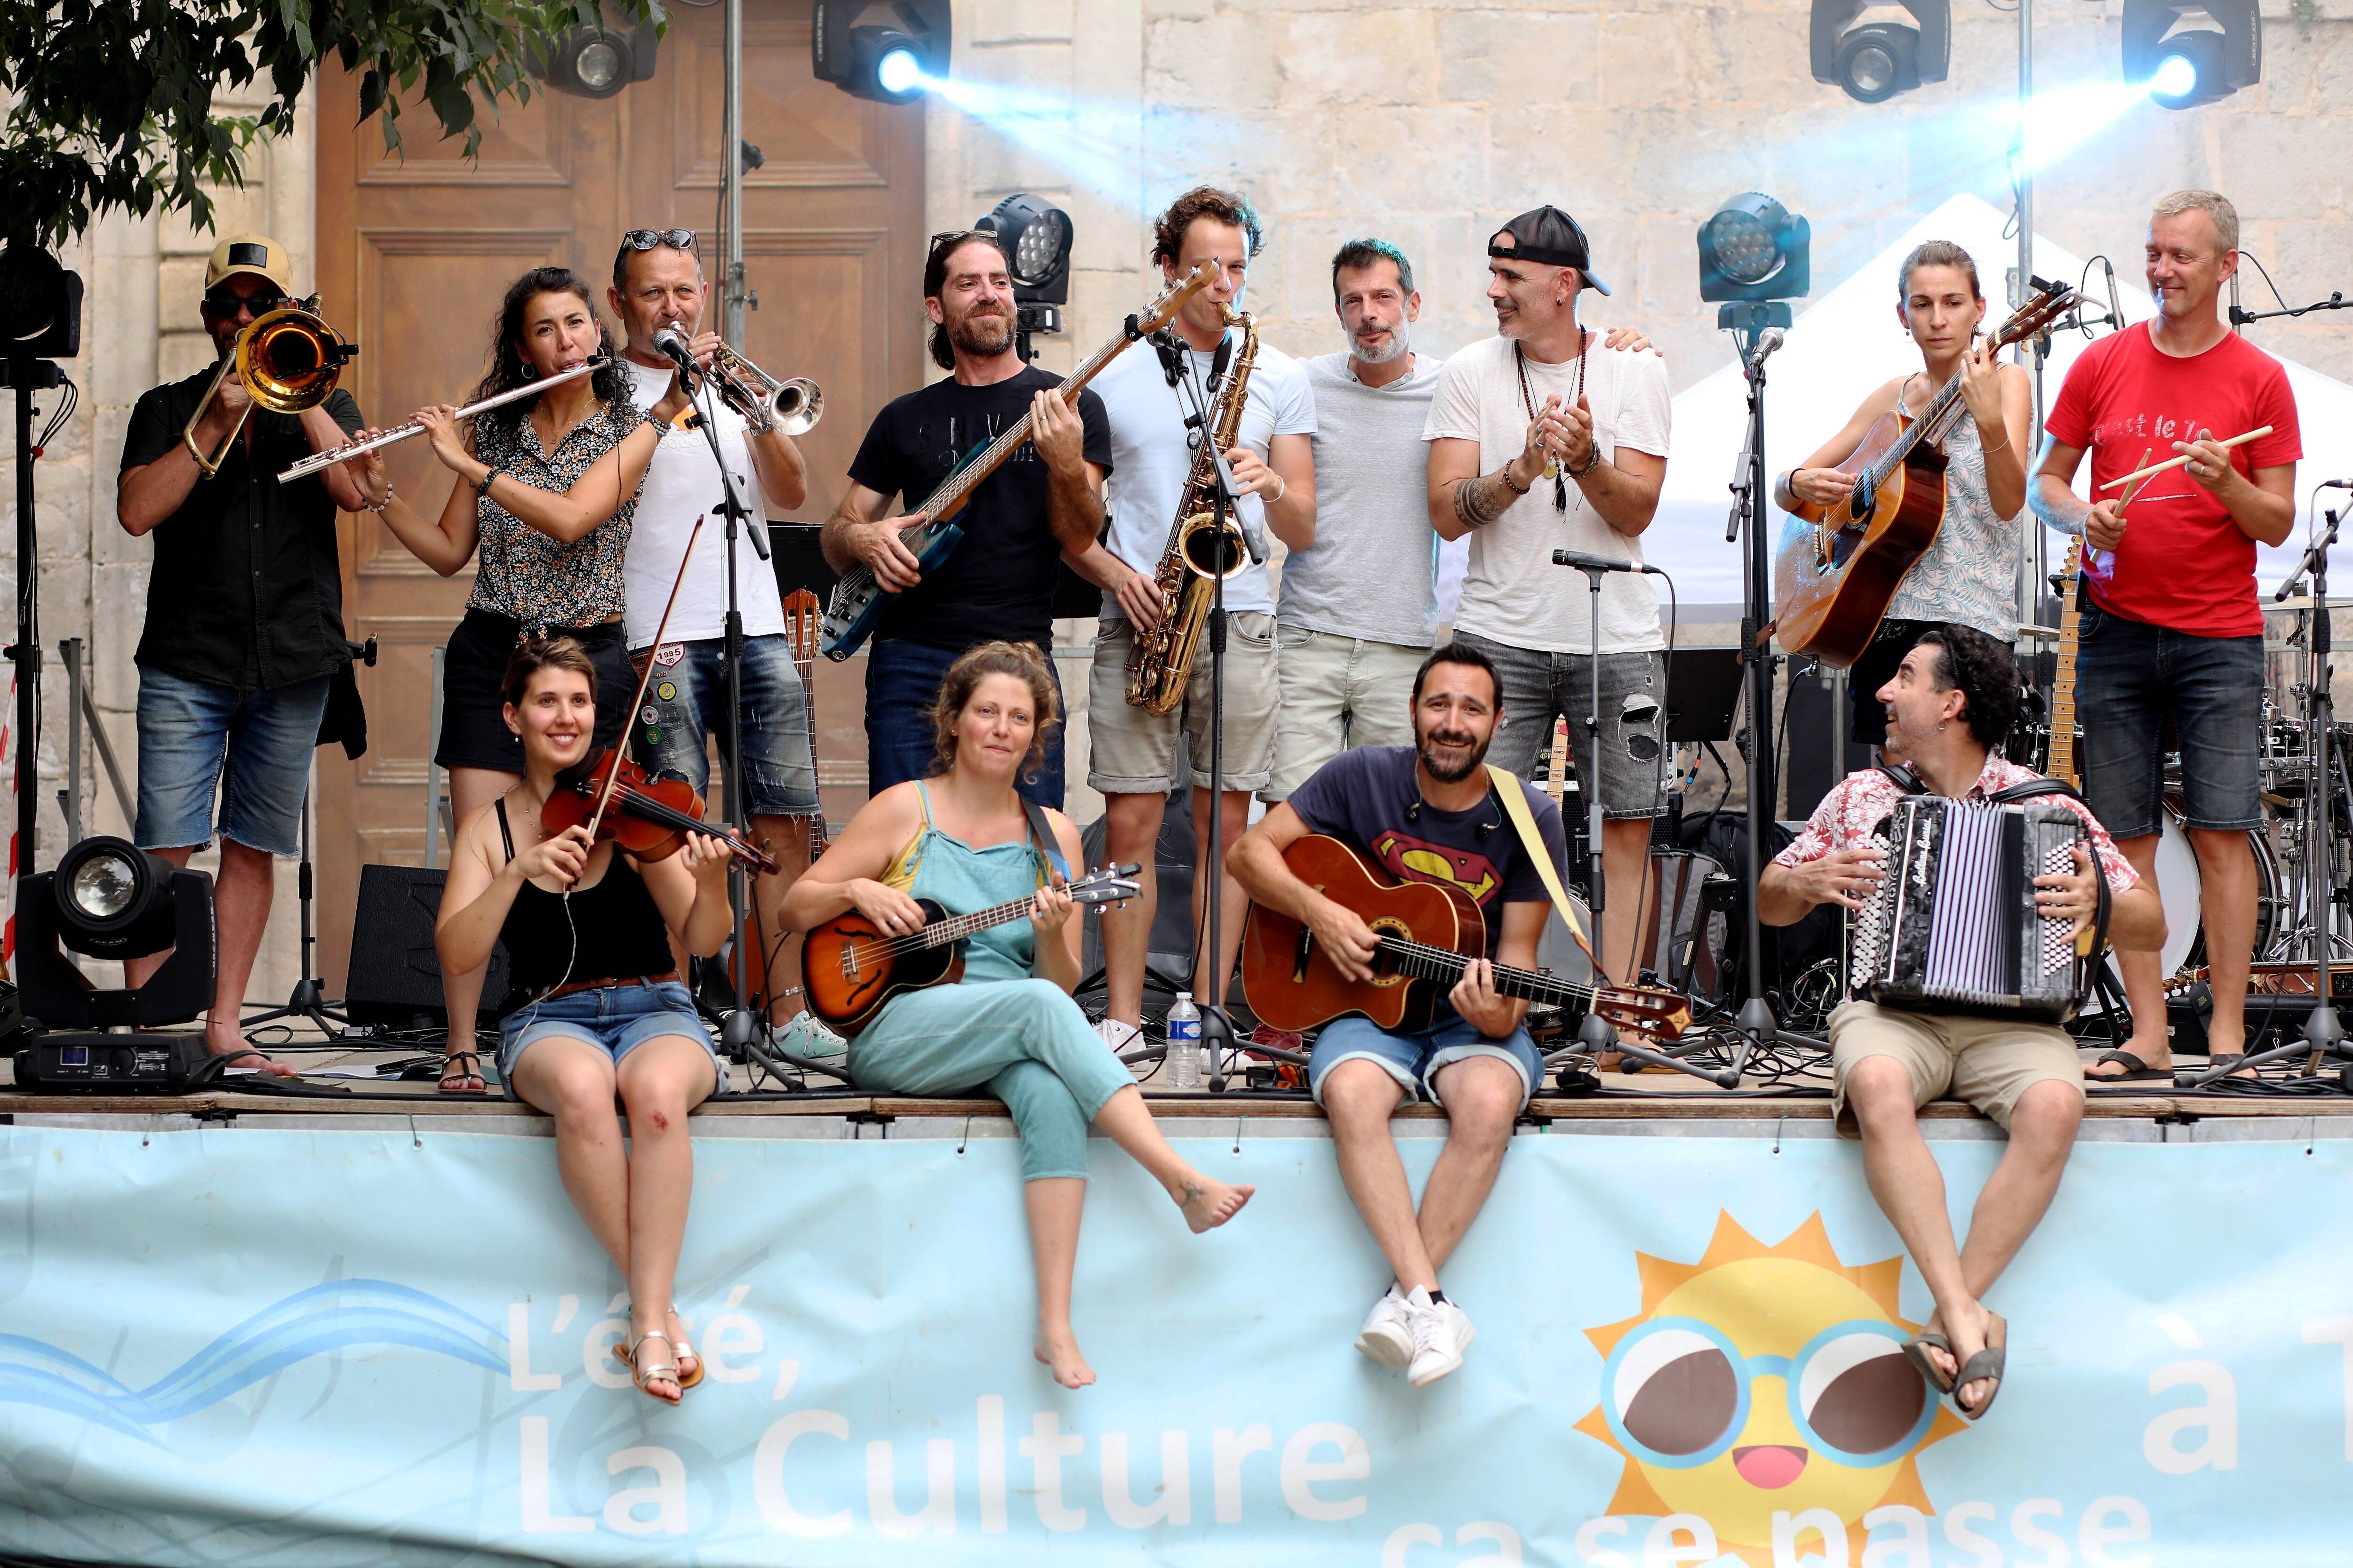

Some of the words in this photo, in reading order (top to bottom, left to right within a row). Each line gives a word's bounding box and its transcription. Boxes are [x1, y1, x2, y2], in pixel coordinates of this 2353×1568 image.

[2154, 414, 2177, 438] le
[657, 648, 681, 660] 1995
[508, 1285, 799, 1401] L'éé,
[2143, 1314, 2238, 1475] à
[520, 1415, 689, 1536] La
[752, 1394, 1371, 1536] Culture
[1575, 1512, 1719, 1568] se
[1769, 1494, 2153, 1568] passe
